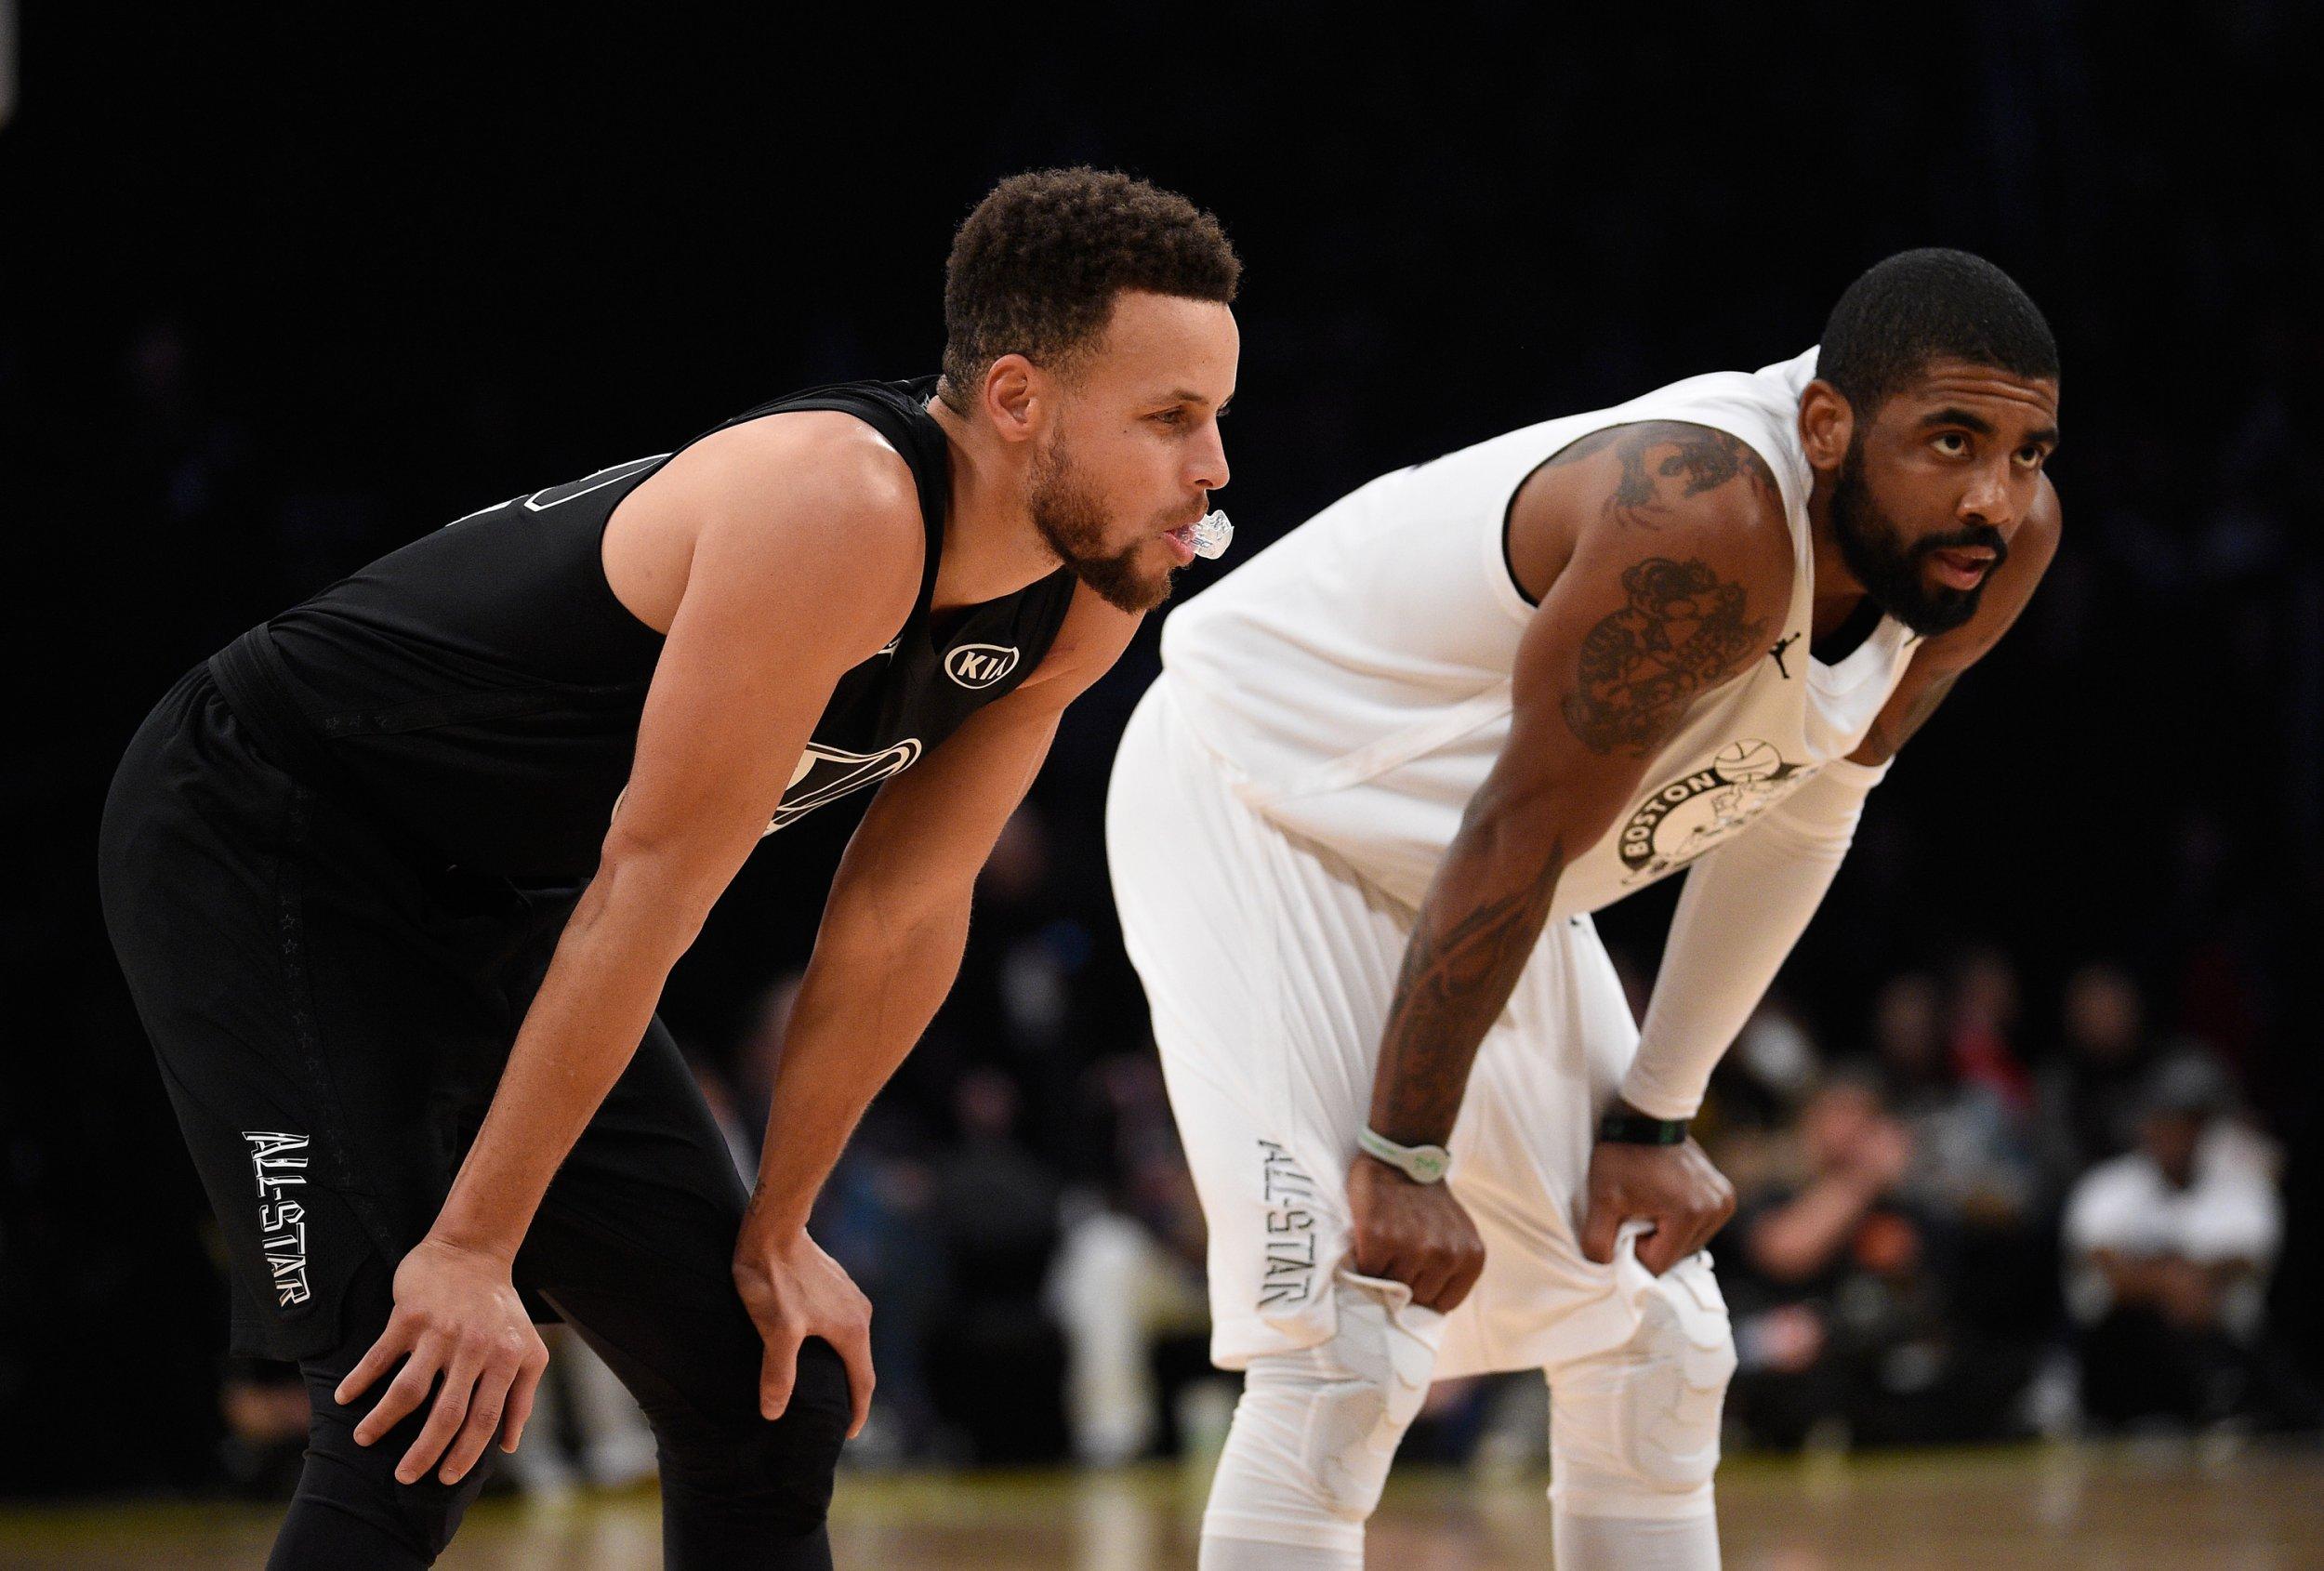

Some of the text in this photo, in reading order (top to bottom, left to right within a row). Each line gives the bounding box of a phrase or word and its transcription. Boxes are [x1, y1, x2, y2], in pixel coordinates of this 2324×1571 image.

[957, 651, 1010, 680] KIA
[1624, 772, 1717, 858] BOSTON
[242, 1130, 310, 1308] ALL-STAR
